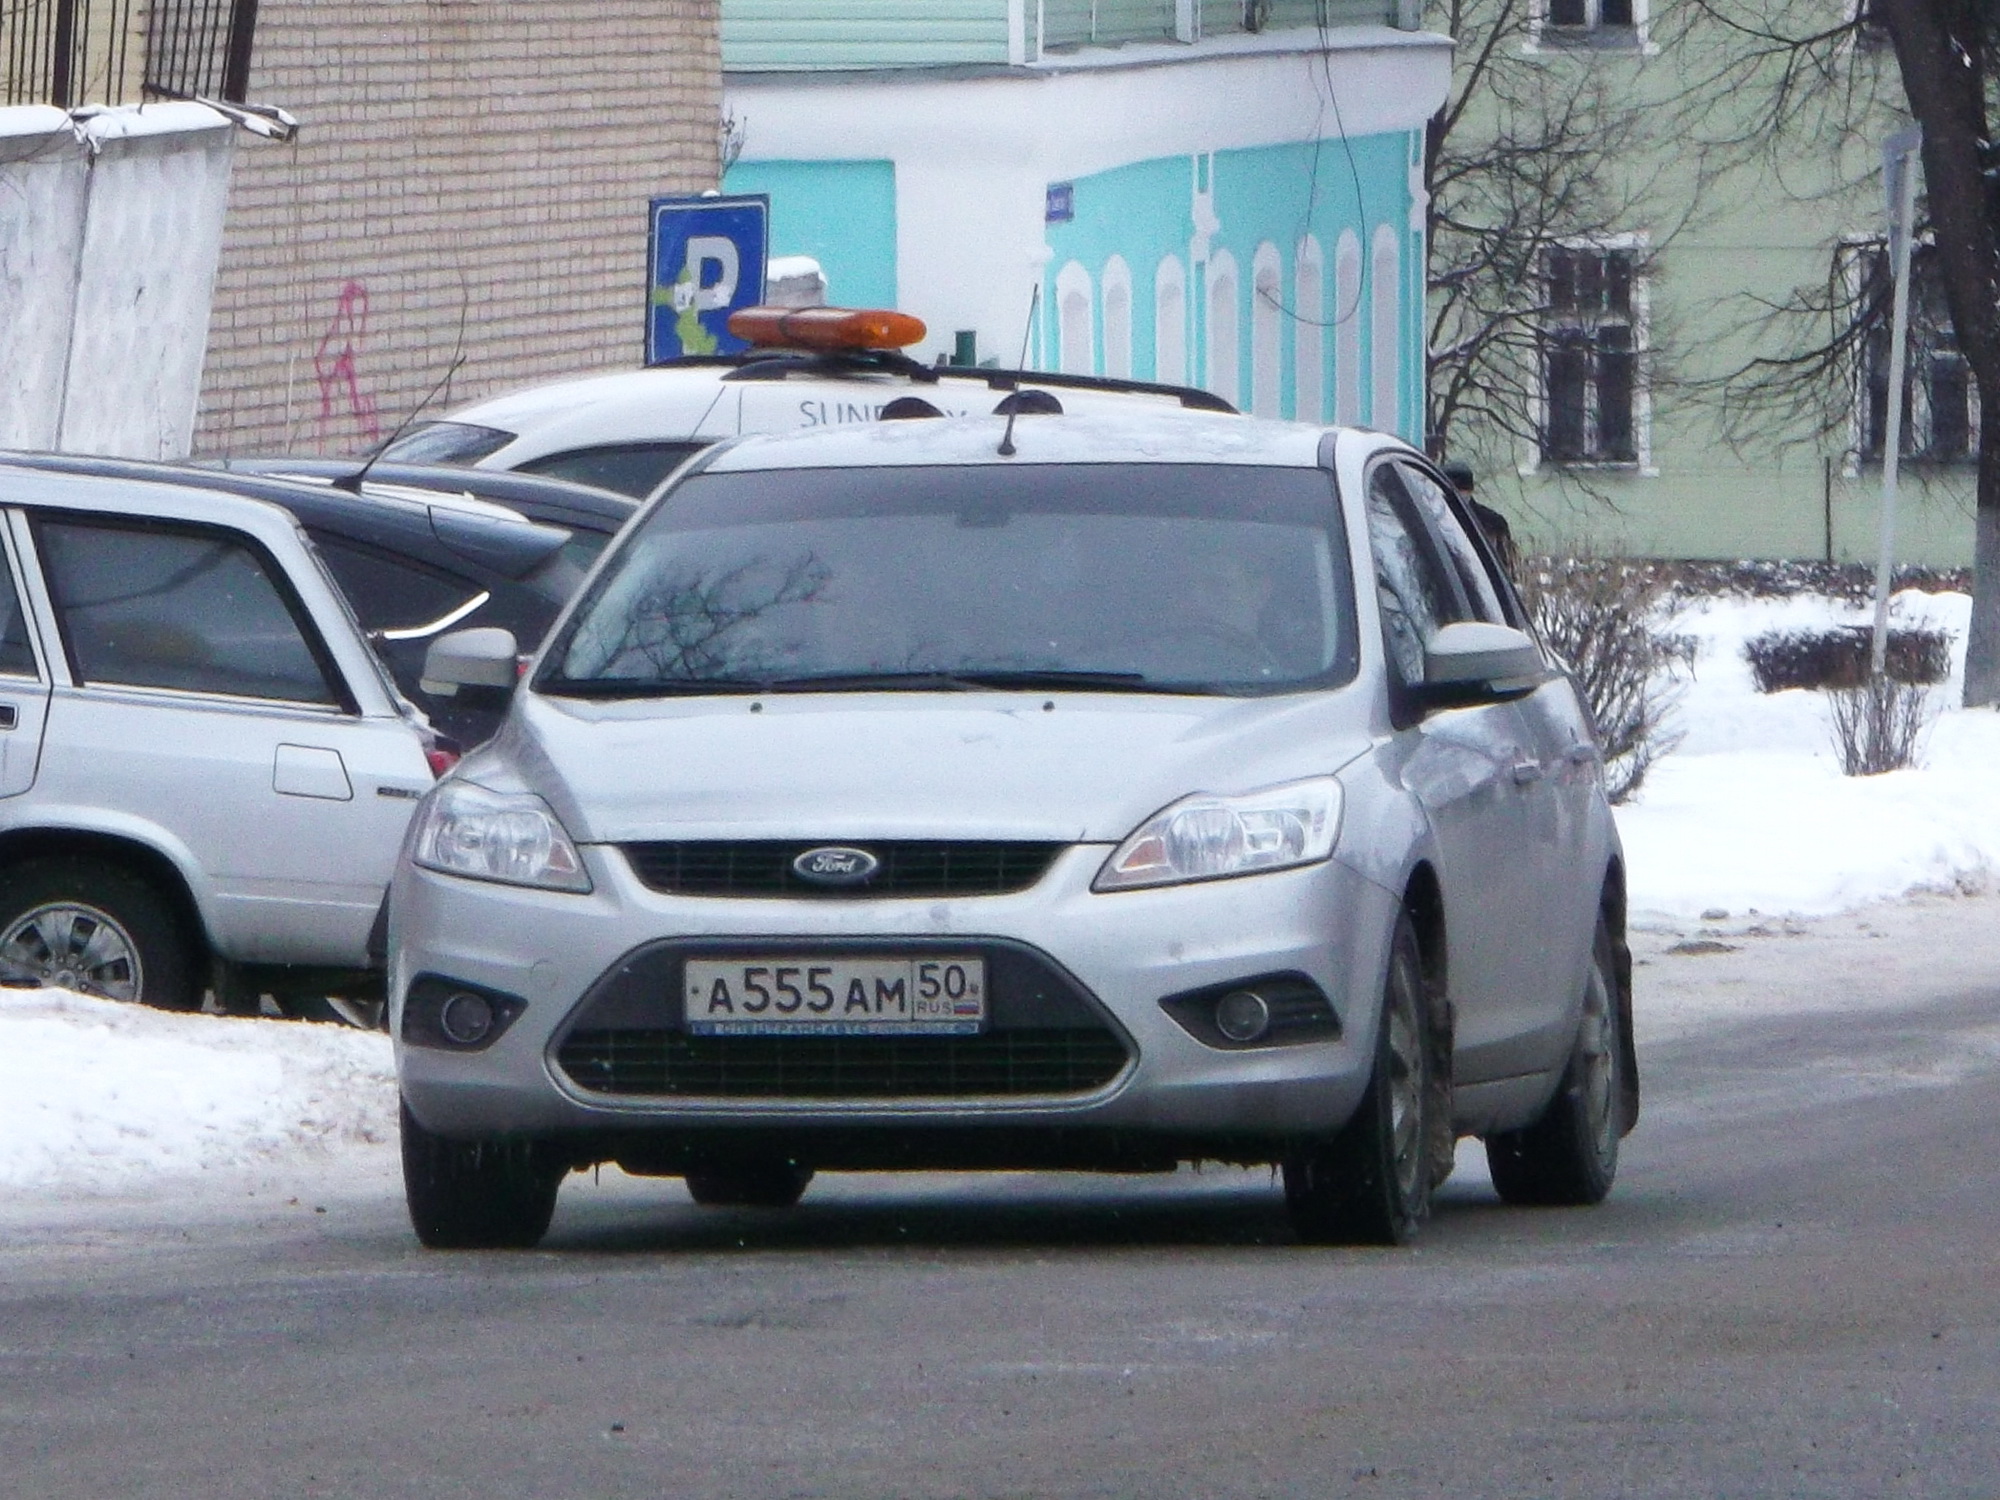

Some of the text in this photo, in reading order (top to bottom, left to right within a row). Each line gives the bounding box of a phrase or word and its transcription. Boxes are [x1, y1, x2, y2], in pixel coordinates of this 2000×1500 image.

[684, 236, 739, 356] P
[812, 854, 857, 873] Ford
[919, 964, 966, 998] 50
[917, 1001, 952, 1014] RUS
